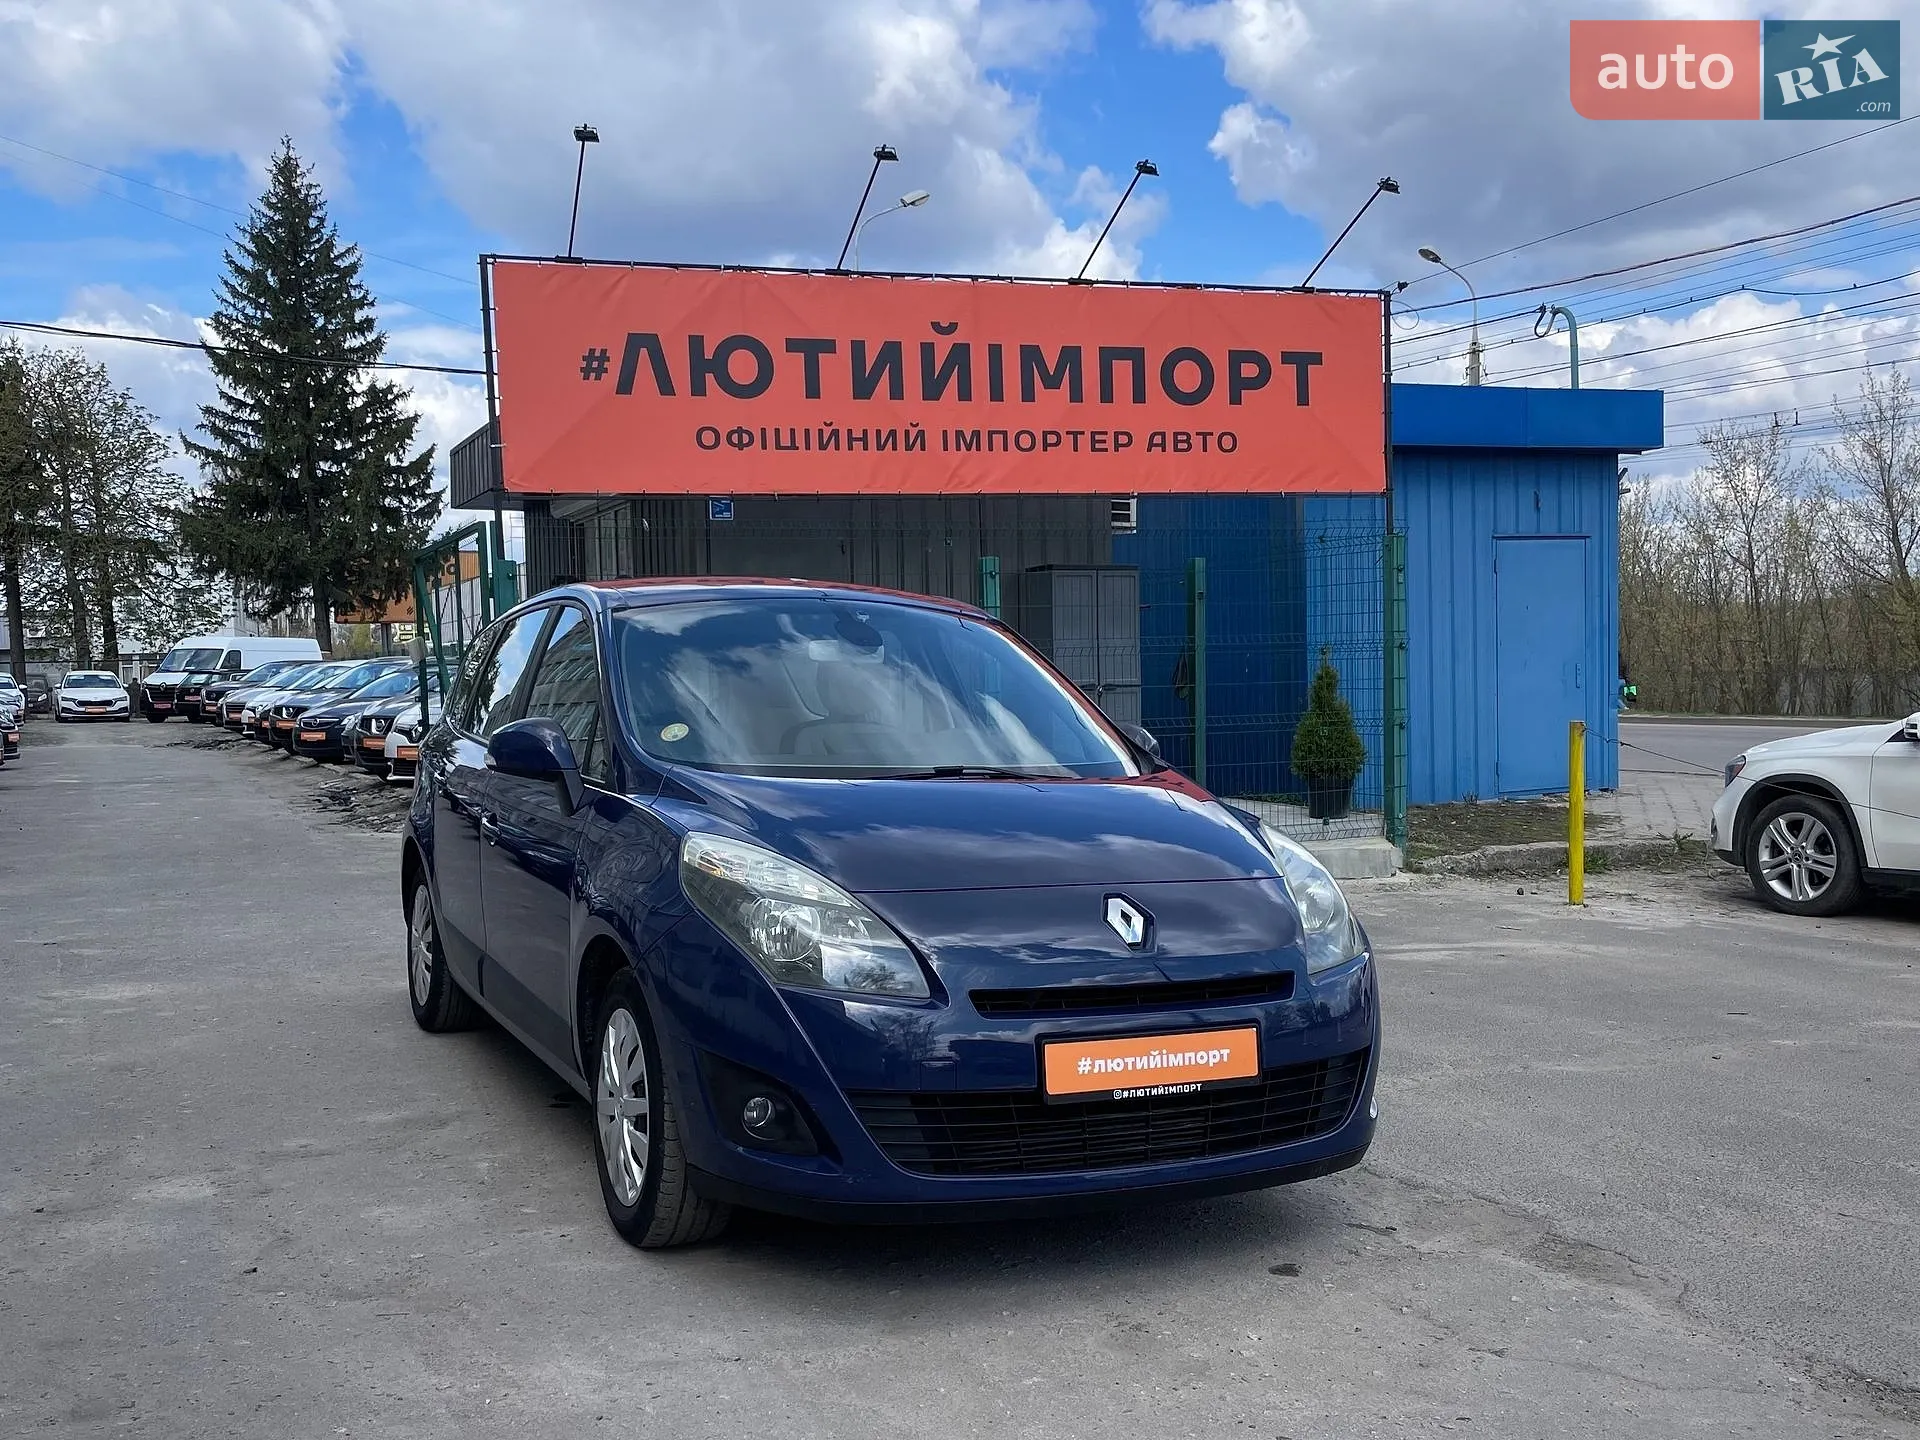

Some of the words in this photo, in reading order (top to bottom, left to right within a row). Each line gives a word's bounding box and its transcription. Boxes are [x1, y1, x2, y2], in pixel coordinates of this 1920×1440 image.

[579, 321, 1323, 407] #ЛЮТИЙІМПОРТ
[695, 421, 926, 454] ОФІЦІЙНИЙ
[942, 429, 1134, 454] ІМПОРТЕР
[1146, 431, 1238, 454] АВТО
[1077, 1048, 1231, 1075] #лютийімпорт
